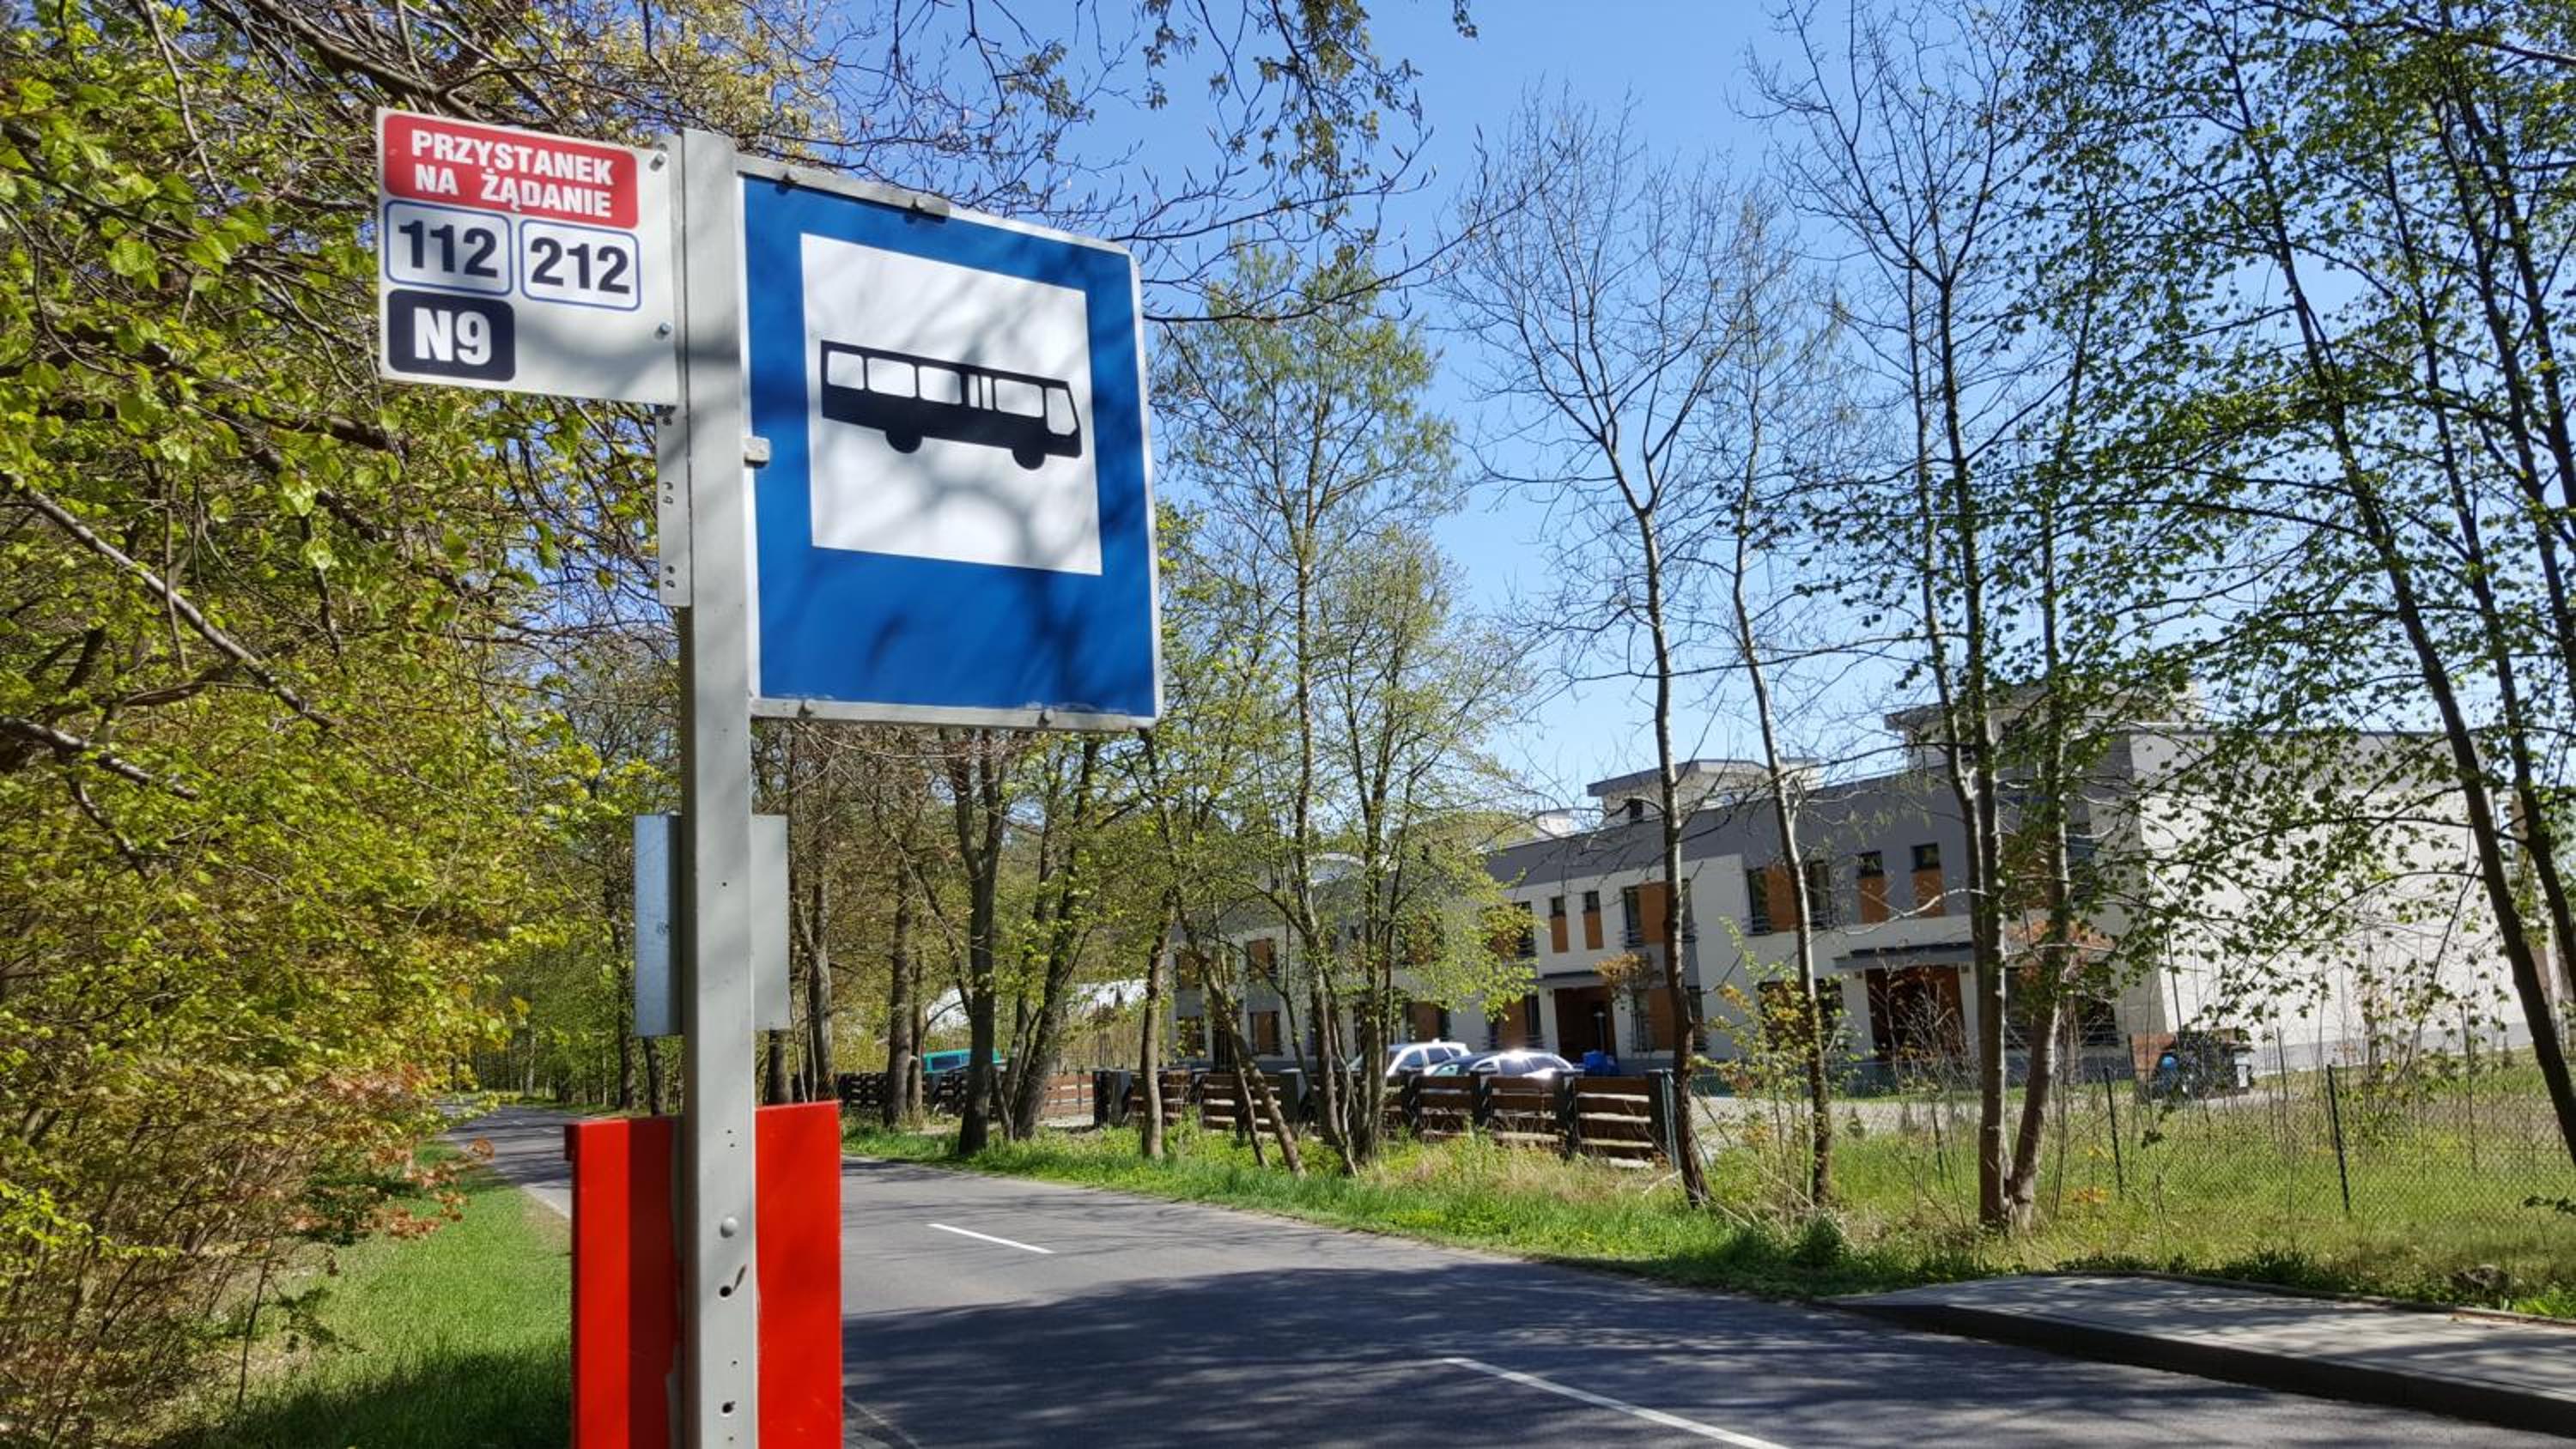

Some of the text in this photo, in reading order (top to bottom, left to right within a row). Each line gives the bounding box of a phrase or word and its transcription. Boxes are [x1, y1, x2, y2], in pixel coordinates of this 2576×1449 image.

[411, 130, 614, 186] PRZYSTANEK
[415, 164, 612, 217] NA ŻĄDANIE
[398, 220, 498, 279] 112
[530, 237, 630, 294] 212
[413, 306, 492, 366] N9
